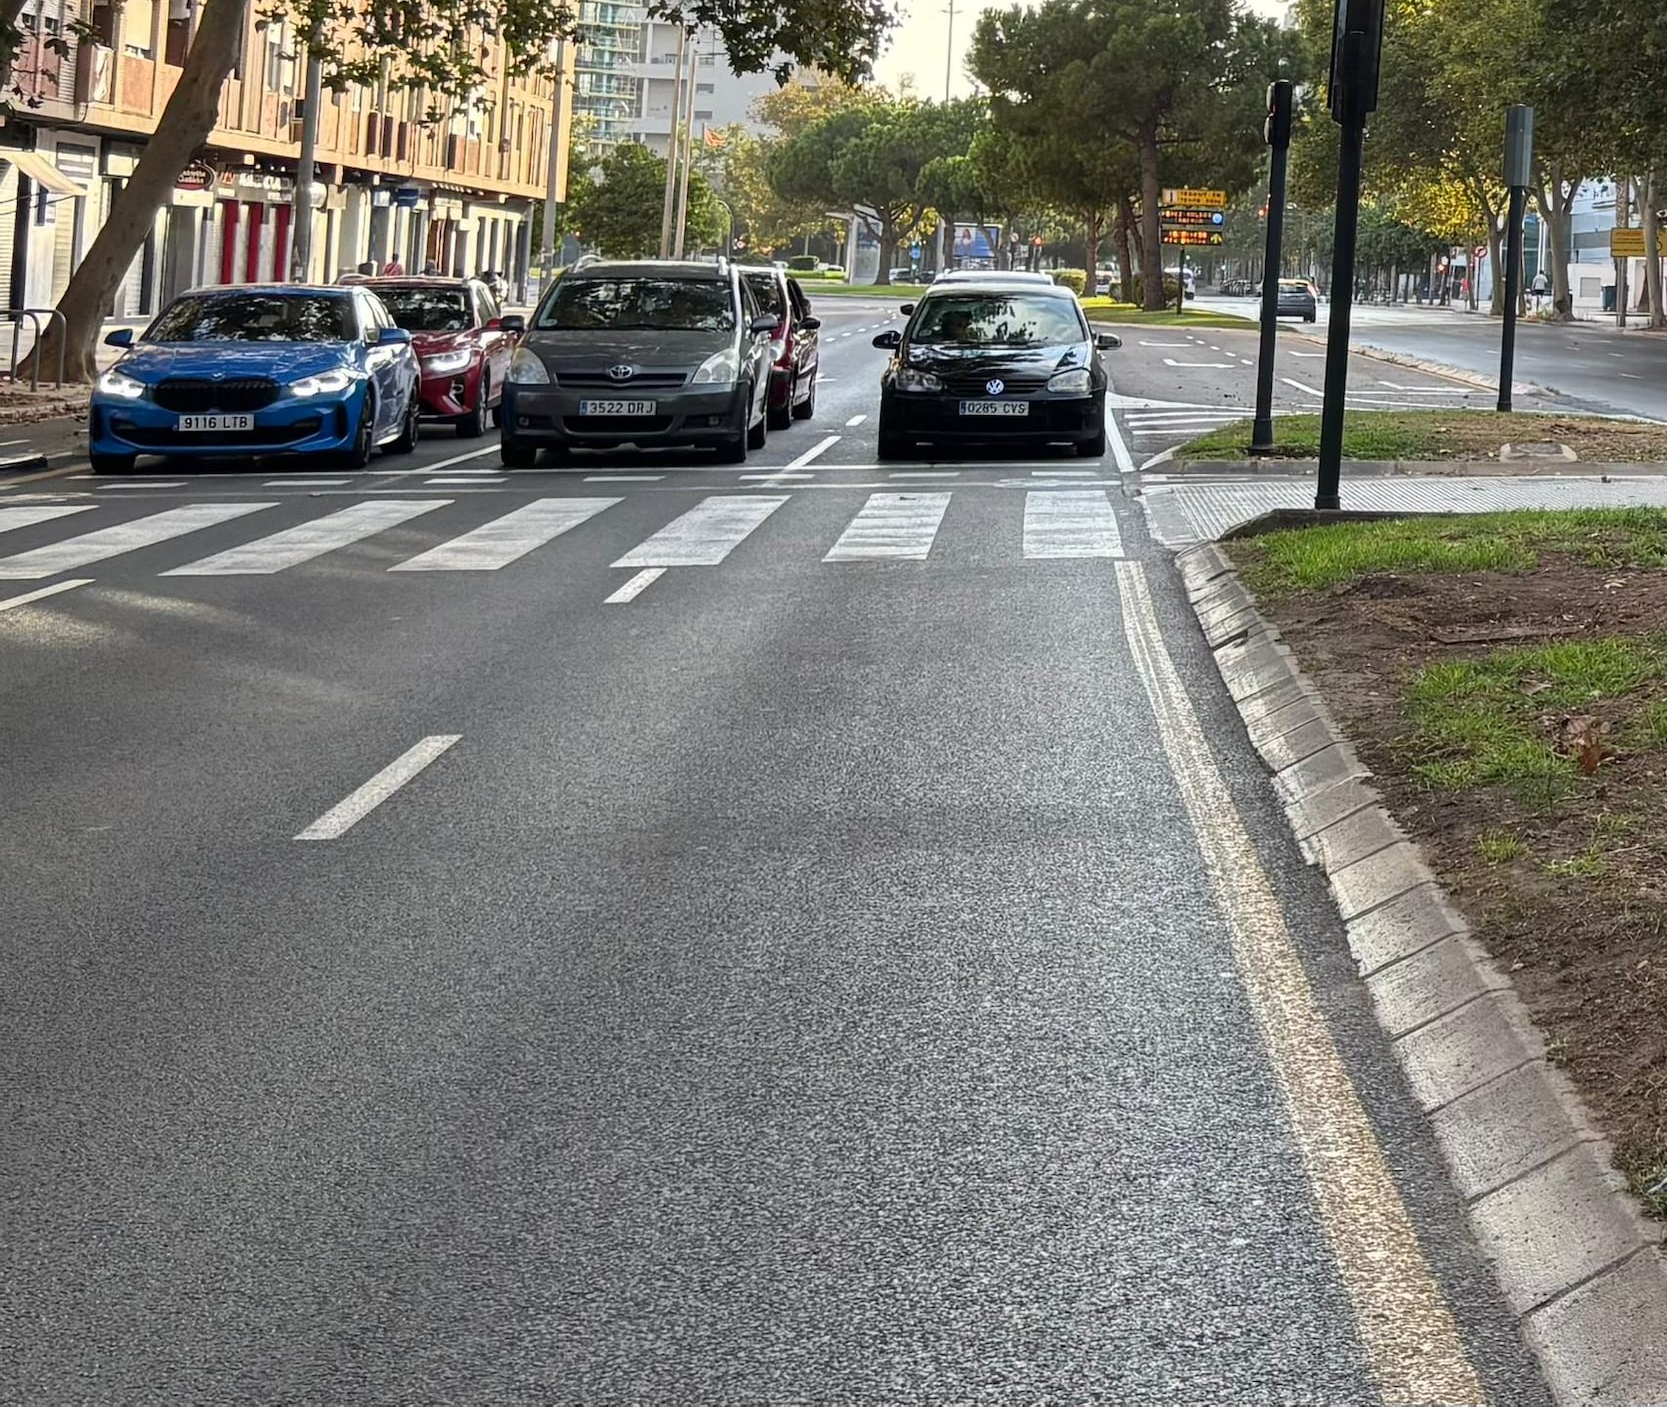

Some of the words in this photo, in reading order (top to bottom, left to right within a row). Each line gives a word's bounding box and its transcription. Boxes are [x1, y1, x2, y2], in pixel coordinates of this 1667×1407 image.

[590, 402, 624, 413] 3522
[627, 402, 653, 413] DRJ
[968, 403, 997, 413] 0285
[1003, 403, 1026, 413] CVS
[184, 417, 217, 428] 9116
[223, 416, 248, 428] LTB
